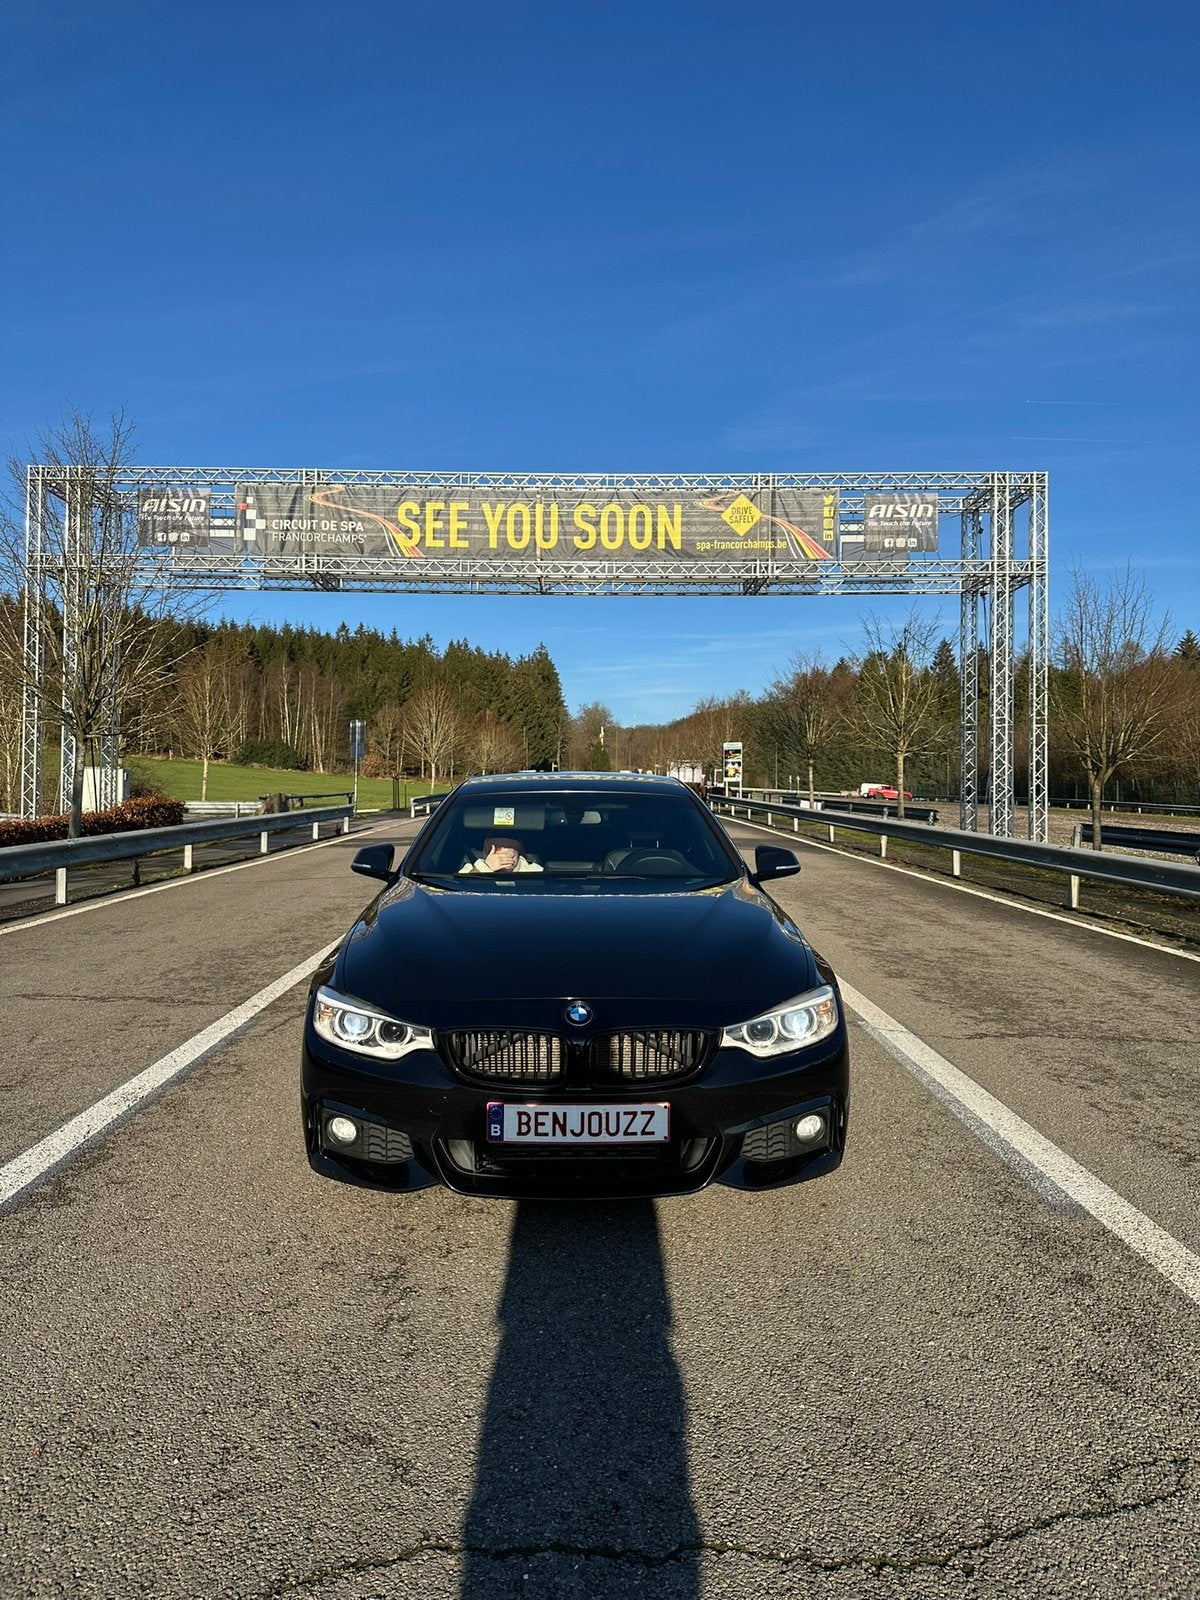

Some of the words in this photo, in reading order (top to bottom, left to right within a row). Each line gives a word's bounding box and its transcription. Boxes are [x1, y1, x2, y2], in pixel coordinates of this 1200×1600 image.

[143, 499, 207, 512] AISIN
[731, 506, 753, 515] DRIVE
[869, 504, 934, 518] AISIN
[272, 519, 319, 530] CIRCUIT
[321, 520, 338, 531] DE
[340, 521, 365, 532] SPA
[397, 501, 469, 548] SEE
[482, 503, 559, 549] YOU
[573, 503, 682, 550] SOON
[729, 515, 755, 524] SAFELY
[272, 532, 365, 544] FRANCORCHAMPS
[695, 539, 788, 552] spa-francorchamps.be
[490, 1124, 501, 1136] B
[516, 1110, 656, 1137] BENJOUZZ
